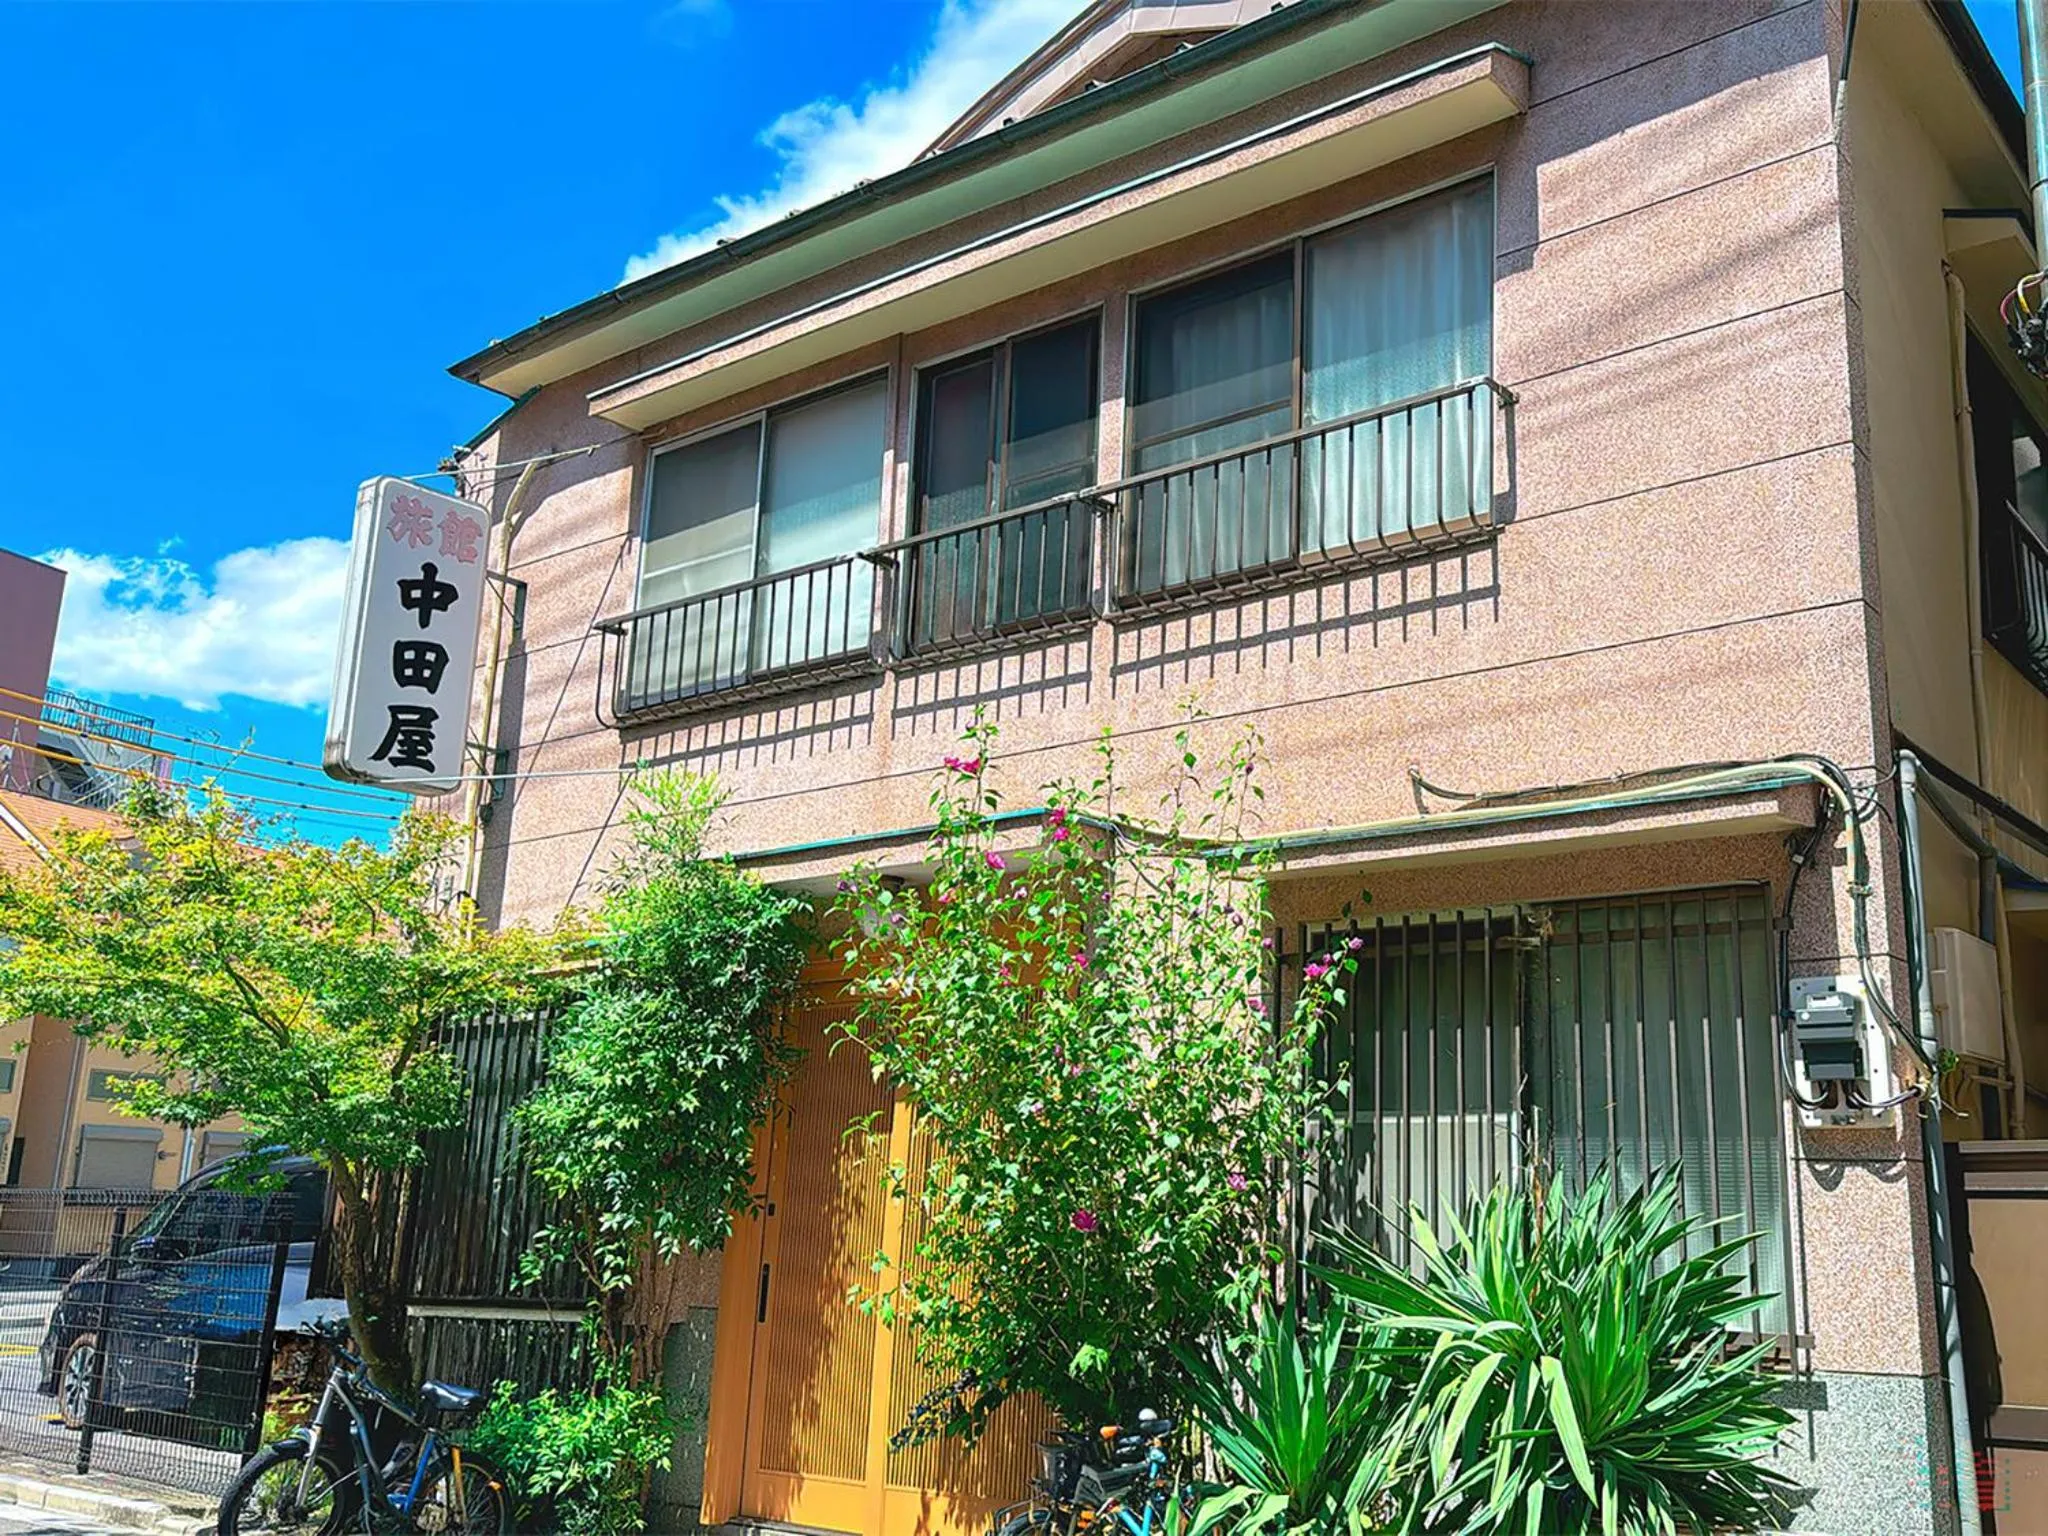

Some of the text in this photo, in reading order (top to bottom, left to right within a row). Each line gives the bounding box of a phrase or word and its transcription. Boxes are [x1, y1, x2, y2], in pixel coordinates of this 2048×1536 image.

[386, 494, 483, 565] 旅館
[367, 562, 459, 773] 中田屋
